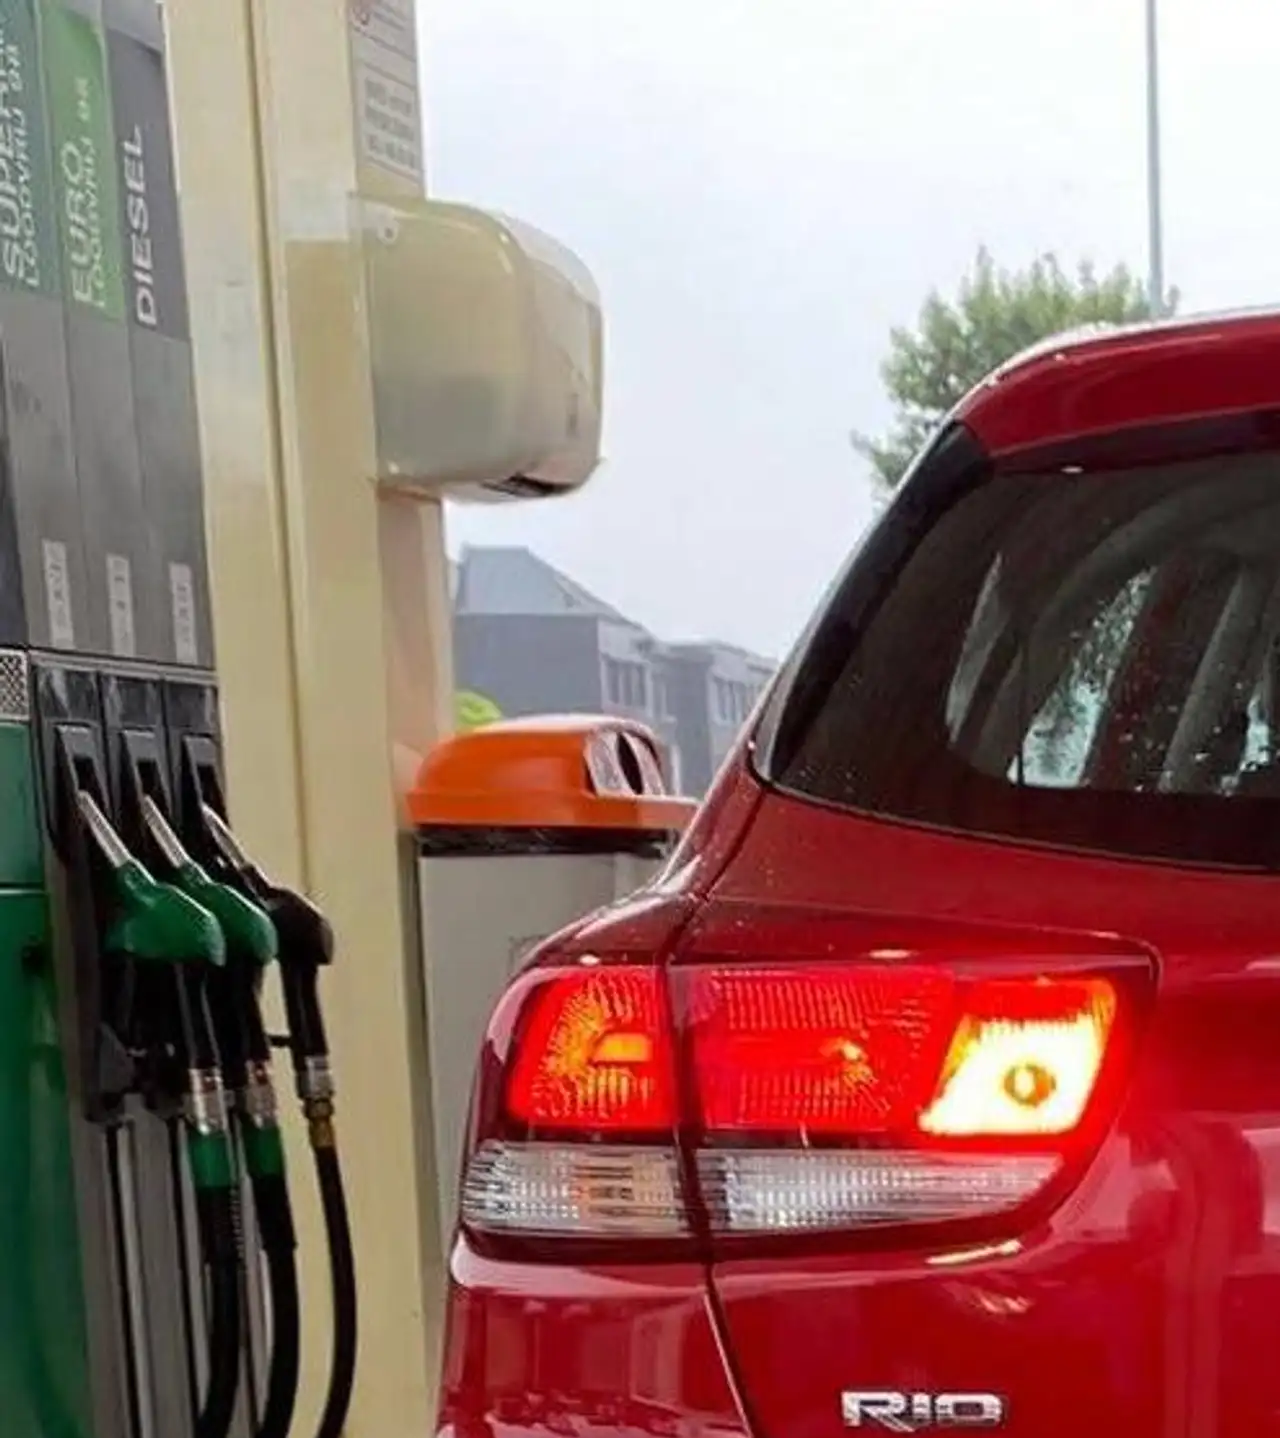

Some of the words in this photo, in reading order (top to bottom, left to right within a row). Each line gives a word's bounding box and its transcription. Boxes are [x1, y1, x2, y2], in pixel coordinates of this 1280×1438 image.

[60, 141, 93, 303] EURO
[123, 123, 157, 326] DIESEL
[841, 1391, 1003, 1433] RIO
